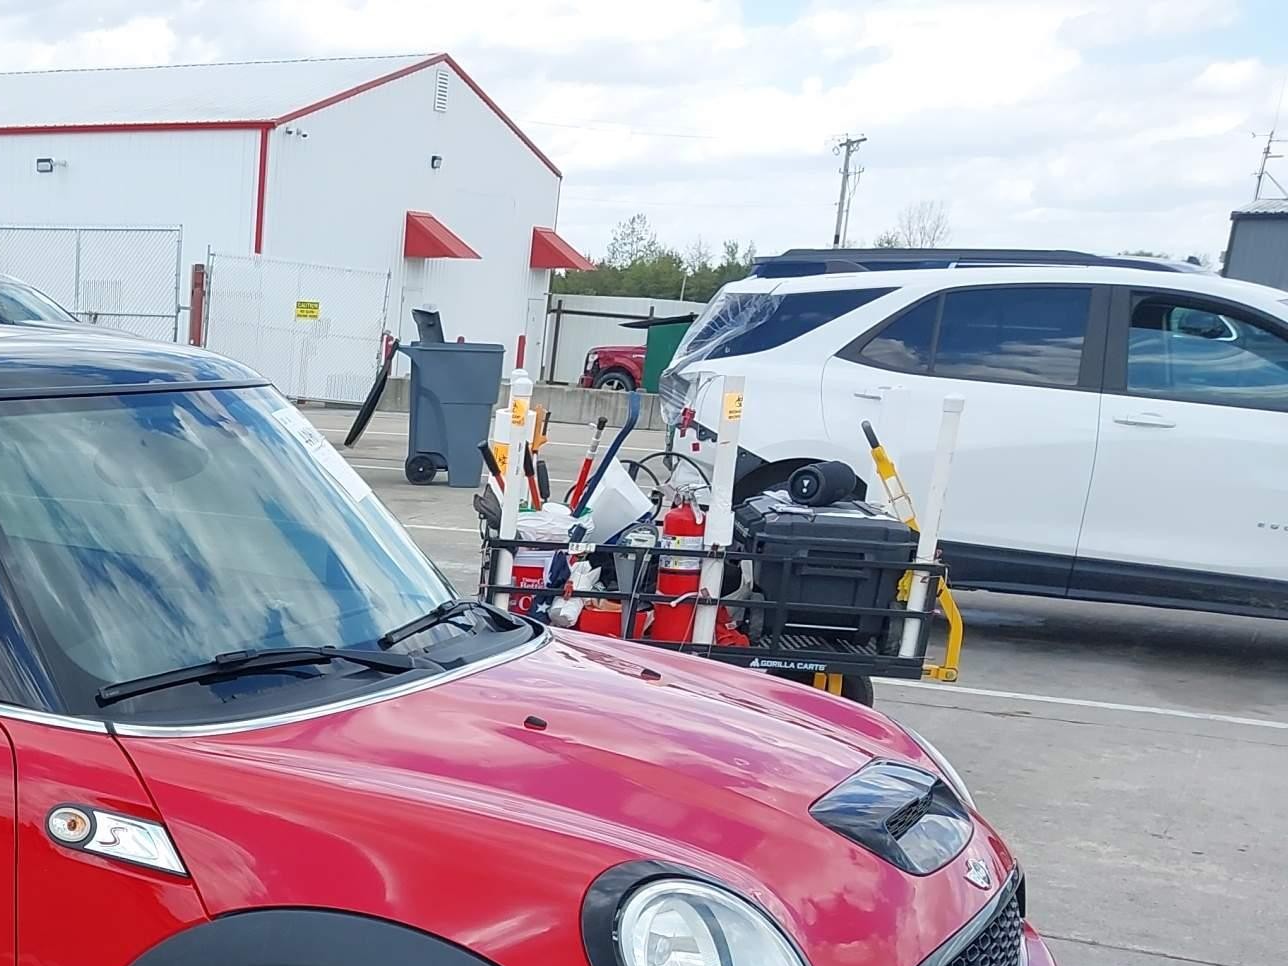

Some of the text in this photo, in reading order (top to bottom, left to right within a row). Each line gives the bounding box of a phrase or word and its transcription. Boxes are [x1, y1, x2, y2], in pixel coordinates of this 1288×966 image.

[760, 660, 826, 671] GORILLA CARTS
[96, 826, 128, 847] S
